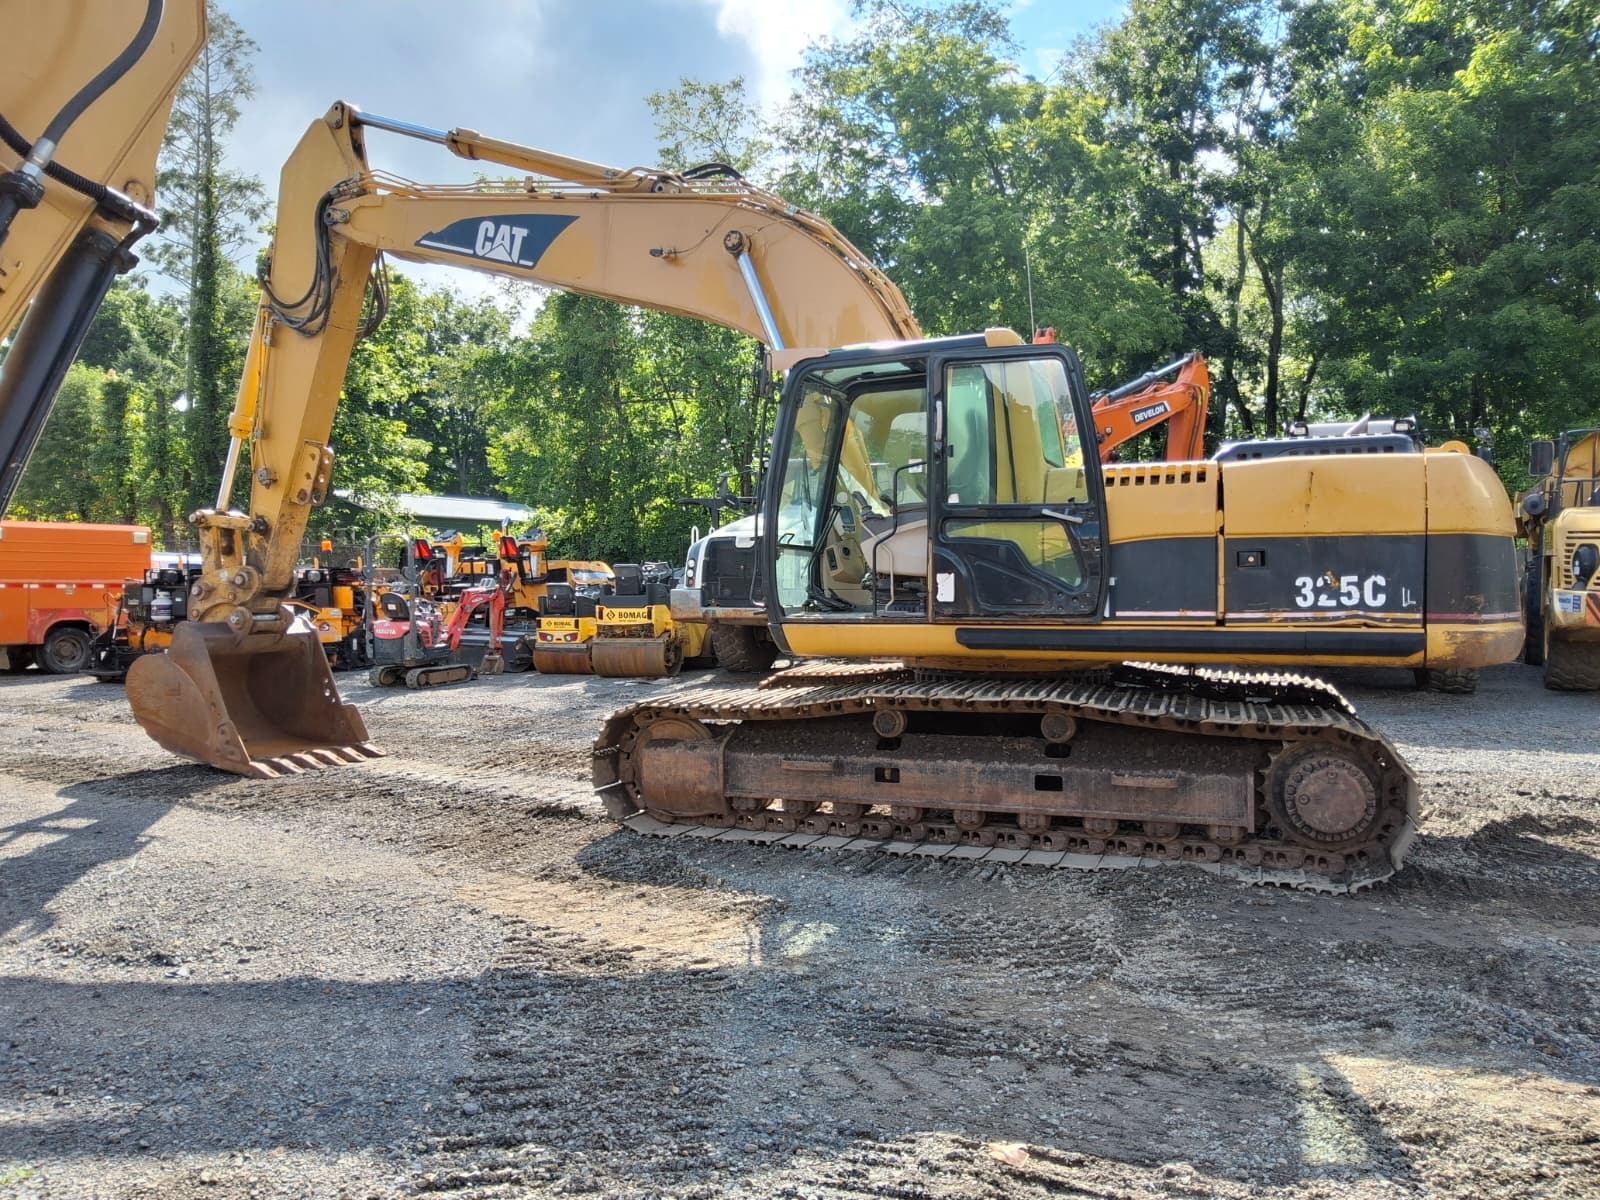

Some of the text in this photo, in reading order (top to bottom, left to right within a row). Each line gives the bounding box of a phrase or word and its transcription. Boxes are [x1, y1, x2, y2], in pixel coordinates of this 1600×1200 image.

[475, 220, 528, 263] CAT
[1134, 402, 1165, 423] DEVELON
[1295, 574, 1387, 607] 325C
[618, 611, 647, 619] BOMAG
